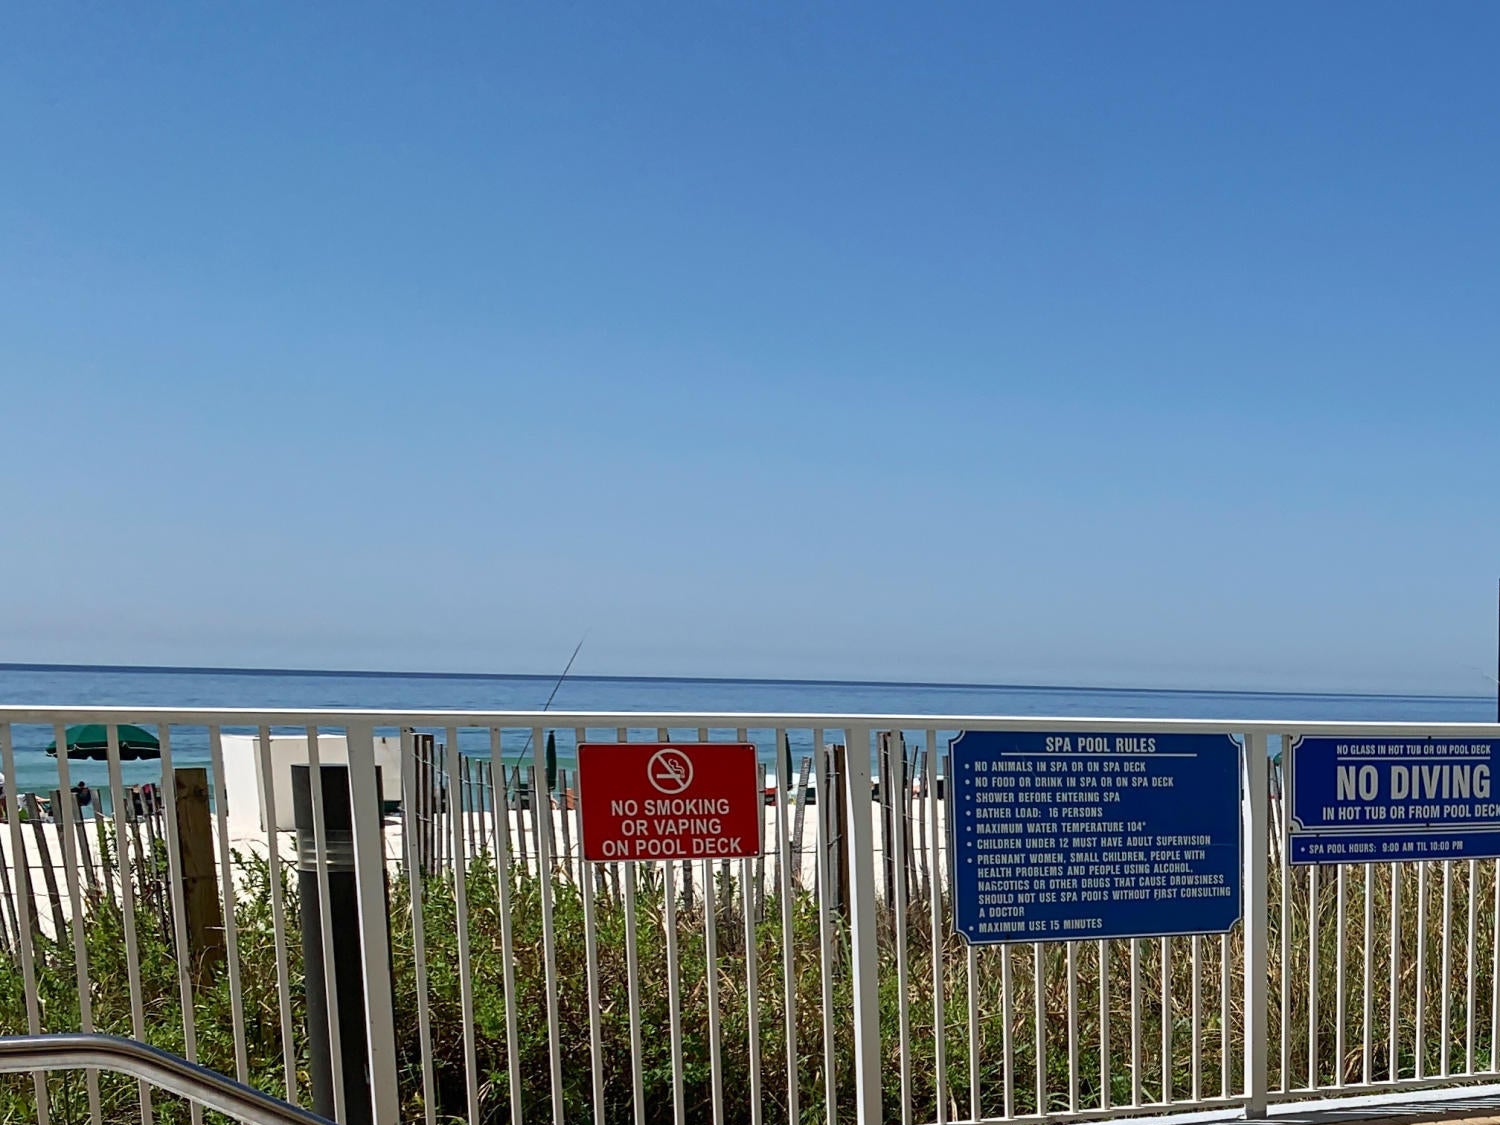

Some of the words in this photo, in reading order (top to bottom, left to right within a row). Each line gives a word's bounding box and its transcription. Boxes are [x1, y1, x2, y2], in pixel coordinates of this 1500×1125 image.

[1046, 737, 1072, 752] SPA
[1077, 737, 1110, 753] POOL
[1116, 738, 1156, 753] RULES
[1337, 745, 1348, 755] NO
[1350, 745, 1376, 754] GLASS
[1378, 745, 1386, 754] IN
[1388, 745, 1403, 754] HOT
[1406, 745, 1421, 754] TUB
[1424, 745, 1435, 754] OR
[1436, 745, 1447, 754] ON
[1450, 744, 1469, 754] POOL
[1471, 744, 1491, 754] DECK
[975, 762, 987, 772] NO
[992, 762, 1033, 772] ANIMALS
[1037, 762, 1046, 772] IN
[1050, 762, 1068, 772] SPA
[1072, 762, 1083, 772] OR
[1087, 762, 1099, 772] ON
[1103, 762, 1120, 772] SPA
[1124, 762, 1146, 772] DECK
[975, 777, 988, 787] NO
[992, 777, 1015, 787] FOOD
[1019, 777, 1031, 787] OR
[1035, 777, 1062, 787] DRINK
[1067, 777, 1076, 787] IN
[1080, 777, 1097, 787] SPA
[1101, 777, 1112, 787] OR
[1116, 777, 1128, 787] ON
[1132, 777, 1148, 787] SPA
[1152, 777, 1174, 787] DECK
[1337, 765, 1379, 800] NO
[1391, 764, 1490, 799] DIVING
[976, 792, 1014, 802] SHOWER
[1019, 792, 1052, 802] BEFORE
[1056, 792, 1100, 802] ENTERING
[1103, 792, 1120, 802] SPA
[611, 800, 638, 816] NO
[644, 799, 730, 816] SMOKING
[976, 808, 1011, 818] BATHER
[1016, 808, 1041, 818] LOAD:
[1049, 808, 1058, 817] 16
[1062, 807, 1102, 817] PERSONS
[1322, 807, 1334, 820] IN
[1338, 807, 1361, 820] HOT
[1364, 806, 1386, 820] TUB
[1390, 806, 1405, 819] OR
[1409, 805, 1440, 819] FROM
[1443, 805, 1471, 818] POOL
[622, 820, 648, 836] OR
[654, 818, 721, 835] VAPING
[976, 824, 1023, 834] MAXIMUM
[1027, 823, 1057, 833] WATER
[1061, 822, 1124, 832] TEMPERATURE
[602, 840, 629, 856] ON
[636, 839, 686, 855] POOL
[692, 837, 742, 854] DECK
[977, 839, 1022, 849] CHILDREN
[1026, 838, 1055, 848] UNDER
[1060, 838, 1068, 848] 12
[1073, 838, 1097, 848] MUST
[1101, 837, 1122, 847] HAVE
[1127, 836, 1153, 847] ADULT
[1156, 836, 1211, 846] SUPERVISION
[1309, 845, 1324, 854] SPA
[1327, 844, 1346, 854] POOL
[1349, 844, 1376, 853] HOURS:
[1382, 843, 1399, 852] 9:00
[1402, 842, 1414, 852] AM
[1417, 842, 1427, 851] TIL
[1430, 841, 1449, 851] 10:00
[1452, 841, 1463, 850] PM
[977, 854, 1025, 864] PREGNANT
[1030, 853, 1066, 864] WOMEN,
[1070, 853, 1099, 863] SMALL
[1102, 852, 1147, 862] CHILDREN,
[1150, 851, 1180, 860] PEOPLE
[1184, 850, 1205, 860] WITH
[978, 868, 1012, 878] HEALTH
[1016, 866, 1063, 877] PROBLEMS
[1067, 866, 1085, 876] AND
[1089, 864, 1120, 875] PEOPLE
[1124, 864, 1150, 874] USING
[1034, 880, 1046, 890] OR
[1050, 879, 1077, 889] OTHER
[1081, 878, 1110, 888] DRUGS
[1114, 877, 1136, 887] THAT
[1140, 876, 1167, 886] CAUSE
[1170, 875, 1224, 885] DROWSINESS
[978, 894, 1014, 904] SHOULD
[1018, 893, 1036, 903] NOT
[1040, 893, 1057, 902] USE
[1061, 892, 1077, 902] SPA
[1112, 890, 1150, 900] WITHOUT
[1154, 888, 1177, 899] FIRST
[1181, 887, 1231, 898] CONSULTING
[979, 908, 985, 918] A
[989, 907, 1025, 918] DOCTOR
[979, 922, 1025, 933] MAXIMUM
[1029, 921, 1046, 930] USE
[1050, 920, 1059, 930] 15
[1064, 919, 1102, 929] MINUTES
